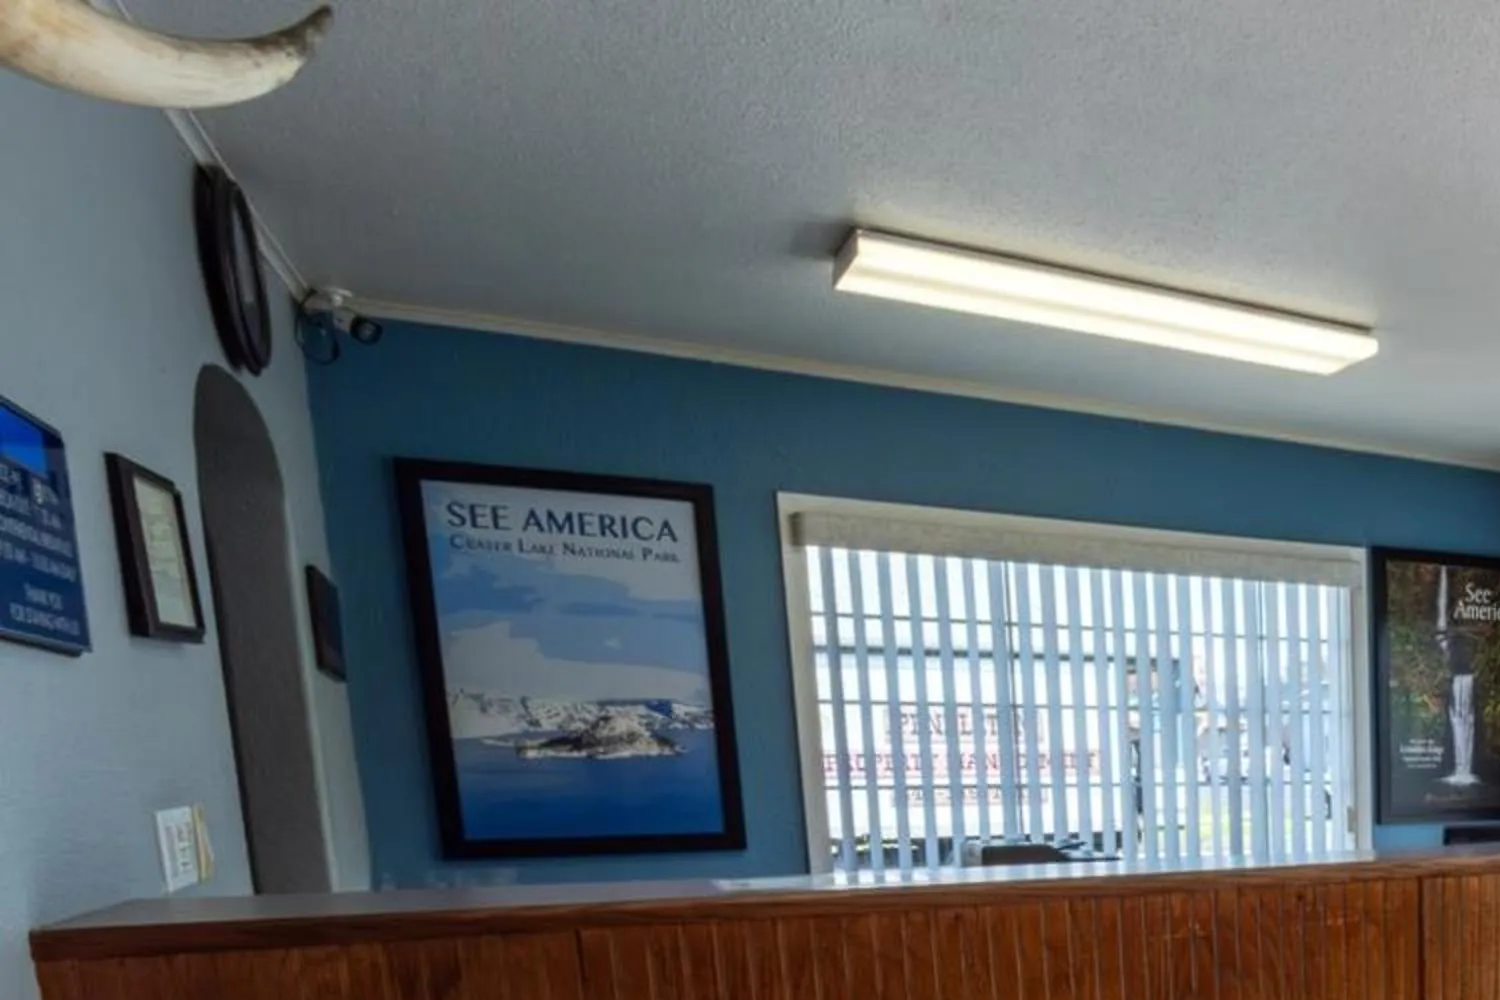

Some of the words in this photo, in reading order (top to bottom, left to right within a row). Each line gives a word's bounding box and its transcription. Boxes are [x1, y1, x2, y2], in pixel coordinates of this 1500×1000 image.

[446, 501, 512, 531] SEE
[522, 507, 679, 543] AMERICA
[1464, 582, 1492, 604] See
